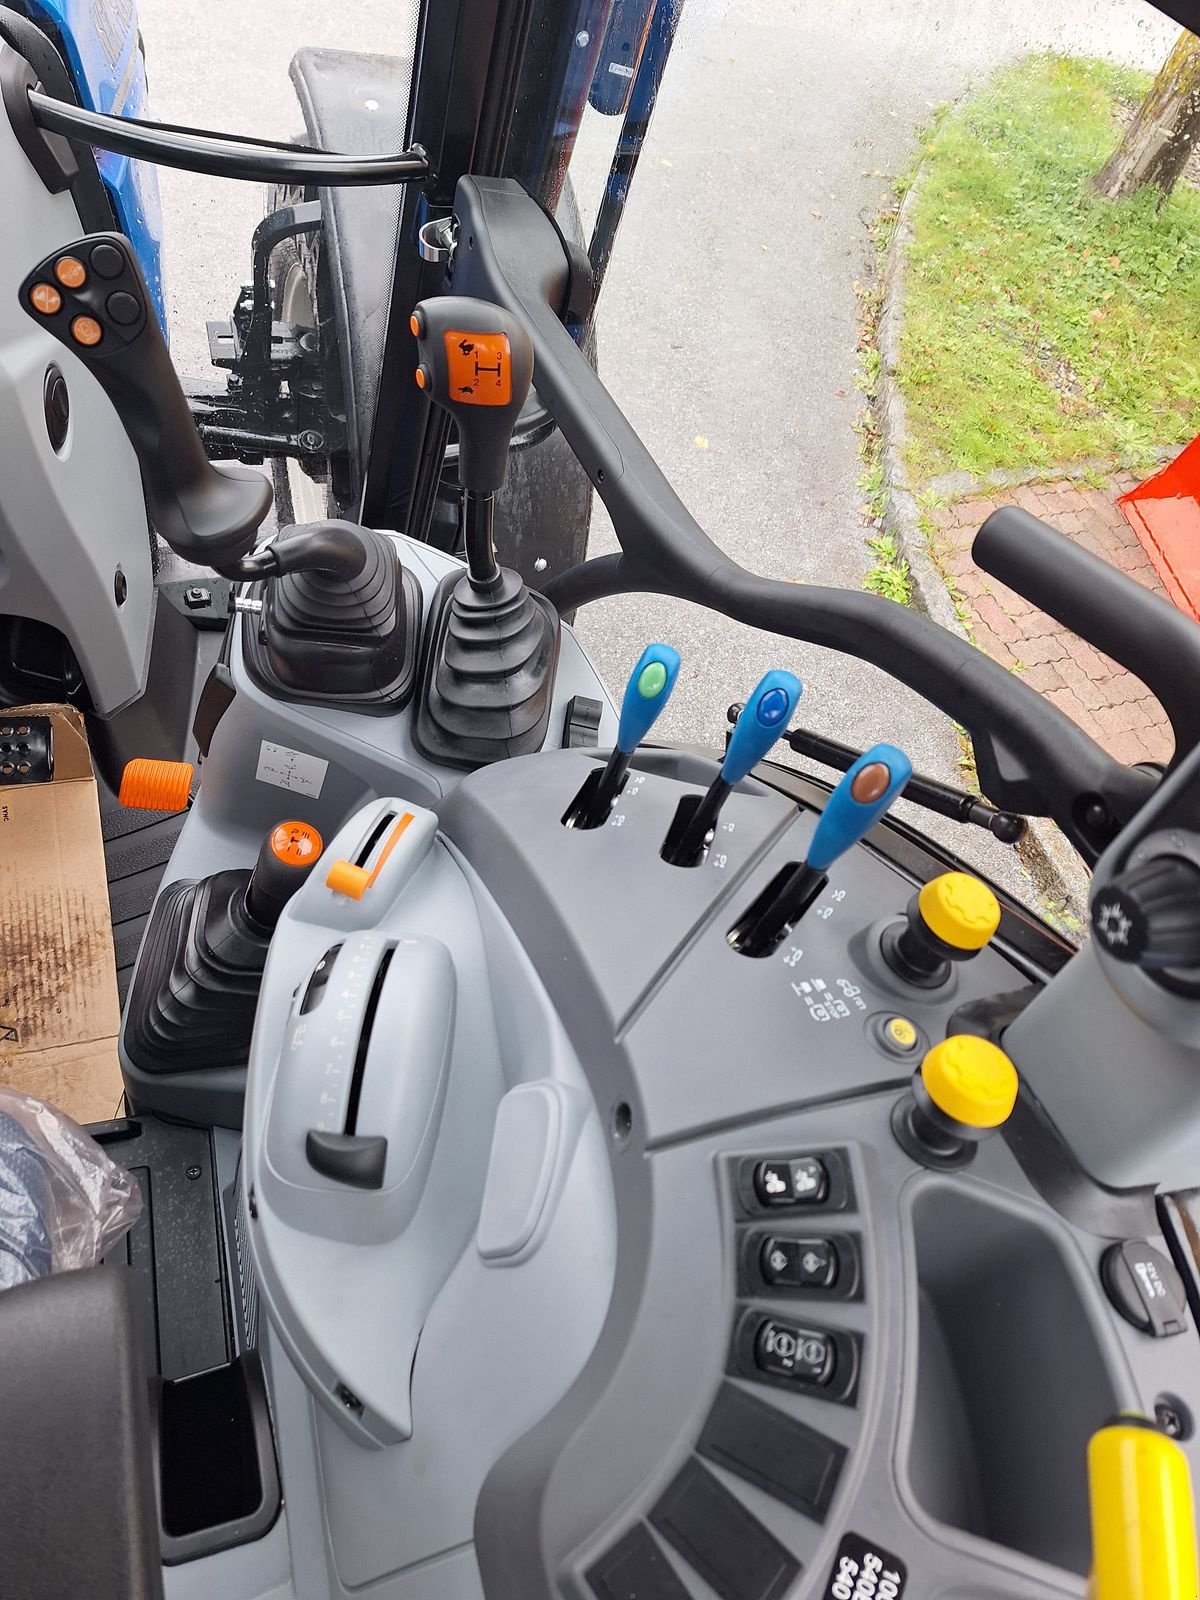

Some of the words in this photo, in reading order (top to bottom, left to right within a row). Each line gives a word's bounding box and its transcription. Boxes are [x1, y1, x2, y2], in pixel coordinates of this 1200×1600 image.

[474, 351, 478, 359] 1
[497, 352, 502, 360] 3
[496, 379, 501, 387] 4
[341, 990, 349, 999] 4
[337, 1009, 344, 1020] 5
[330, 1035, 338, 1047] 6
[326, 1063, 334, 1075] 7
[320, 1092, 328, 1104] 8
[831, 1556, 859, 1600] 540
